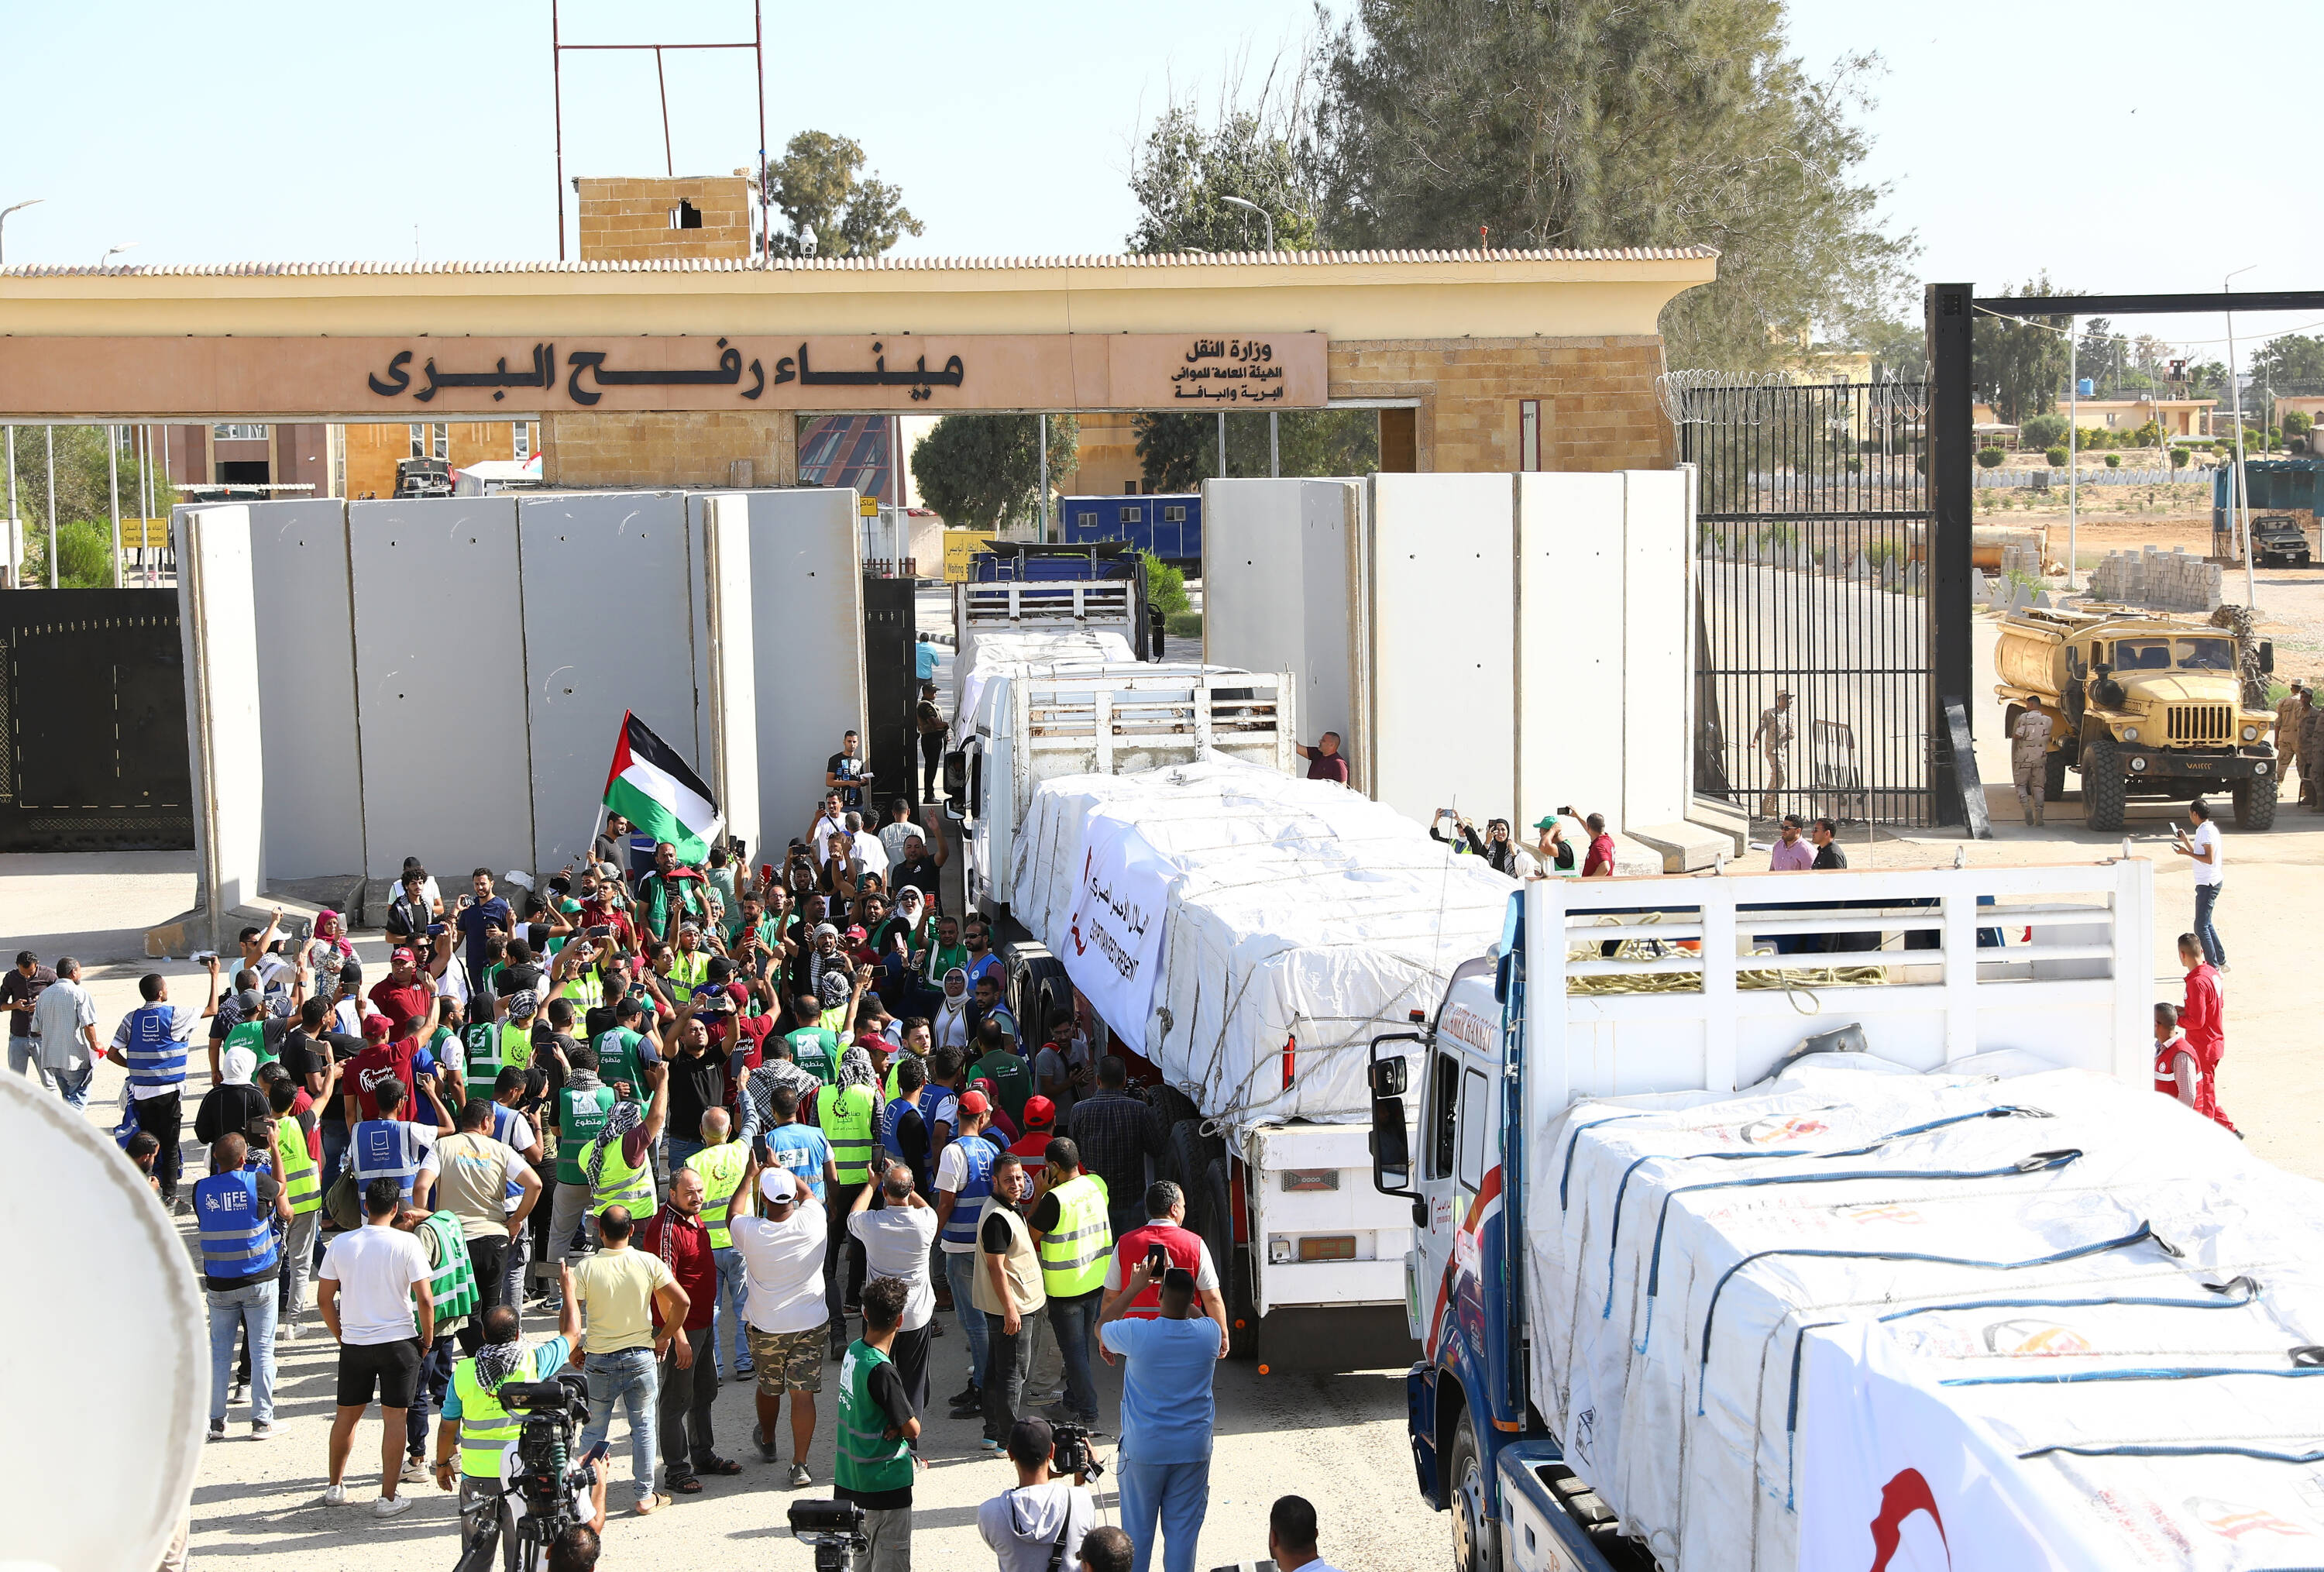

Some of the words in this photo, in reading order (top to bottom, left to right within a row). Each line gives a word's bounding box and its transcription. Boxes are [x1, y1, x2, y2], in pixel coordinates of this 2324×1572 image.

[1186, 339, 1225, 362] النقل
[1230, 339, 1271, 362] وزارة
[568, 337, 765, 405] رفح
[775, 341, 964, 401] ميناء
[1213, 366, 1247, 378] العامة
[1249, 365, 1282, 381] الهيئة
[1174, 385, 1237, 401] والجافة
[1241, 385, 1284, 401] البرية
[947, 563, 964, 576] Waiting
[799, 1061, 824, 1069] متطوع
[575, 1118, 602, 1127] متطوع
[223, 1191, 247, 1212] LiFE
